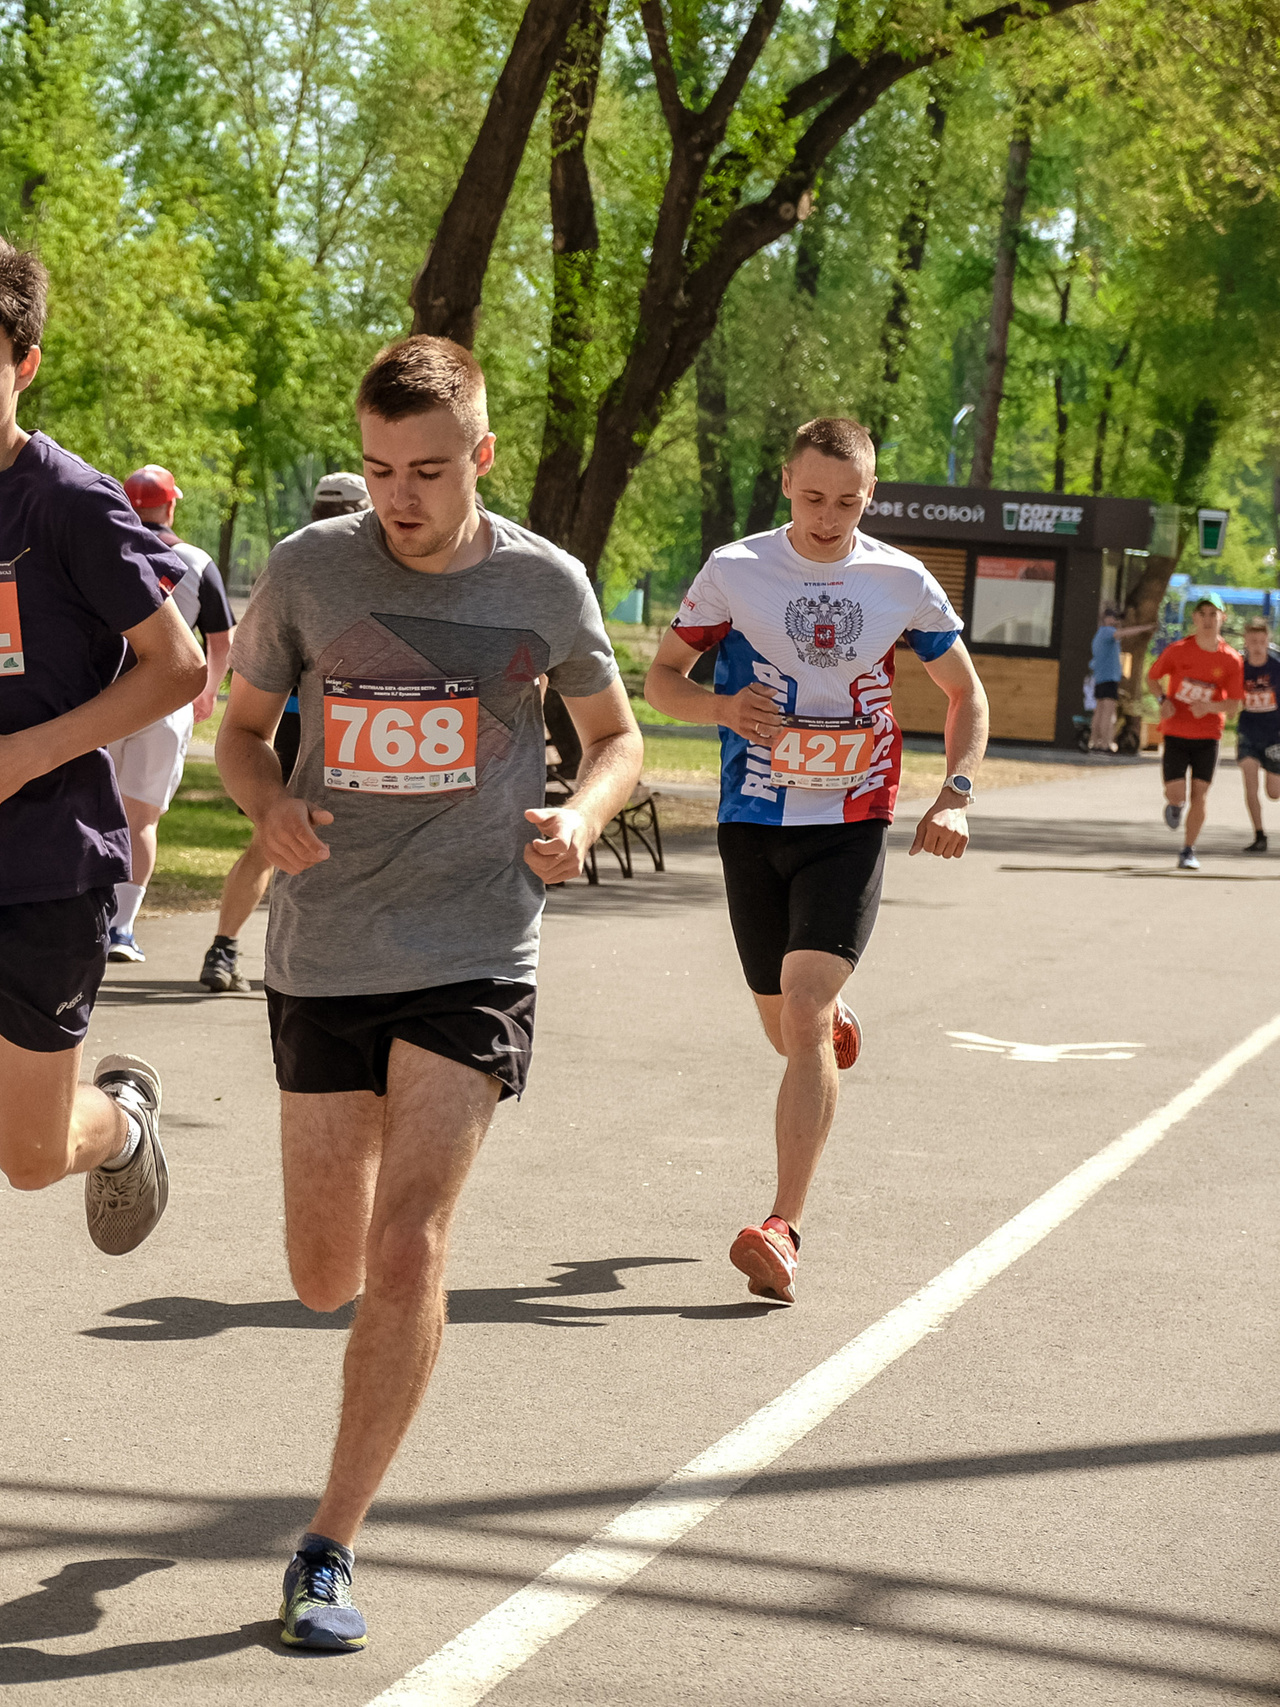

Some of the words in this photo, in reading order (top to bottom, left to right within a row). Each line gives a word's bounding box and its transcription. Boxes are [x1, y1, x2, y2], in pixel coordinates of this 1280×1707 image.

[864, 500, 904, 518] ОФЕ
[907, 502, 921, 519] С
[922, 503, 986, 523] СОБОЙ
[1021, 502, 1084, 523] COFFEE
[1018, 518, 1055, 533] LIKE
[331, 704, 465, 767] 768
[774, 732, 867, 772] 427
